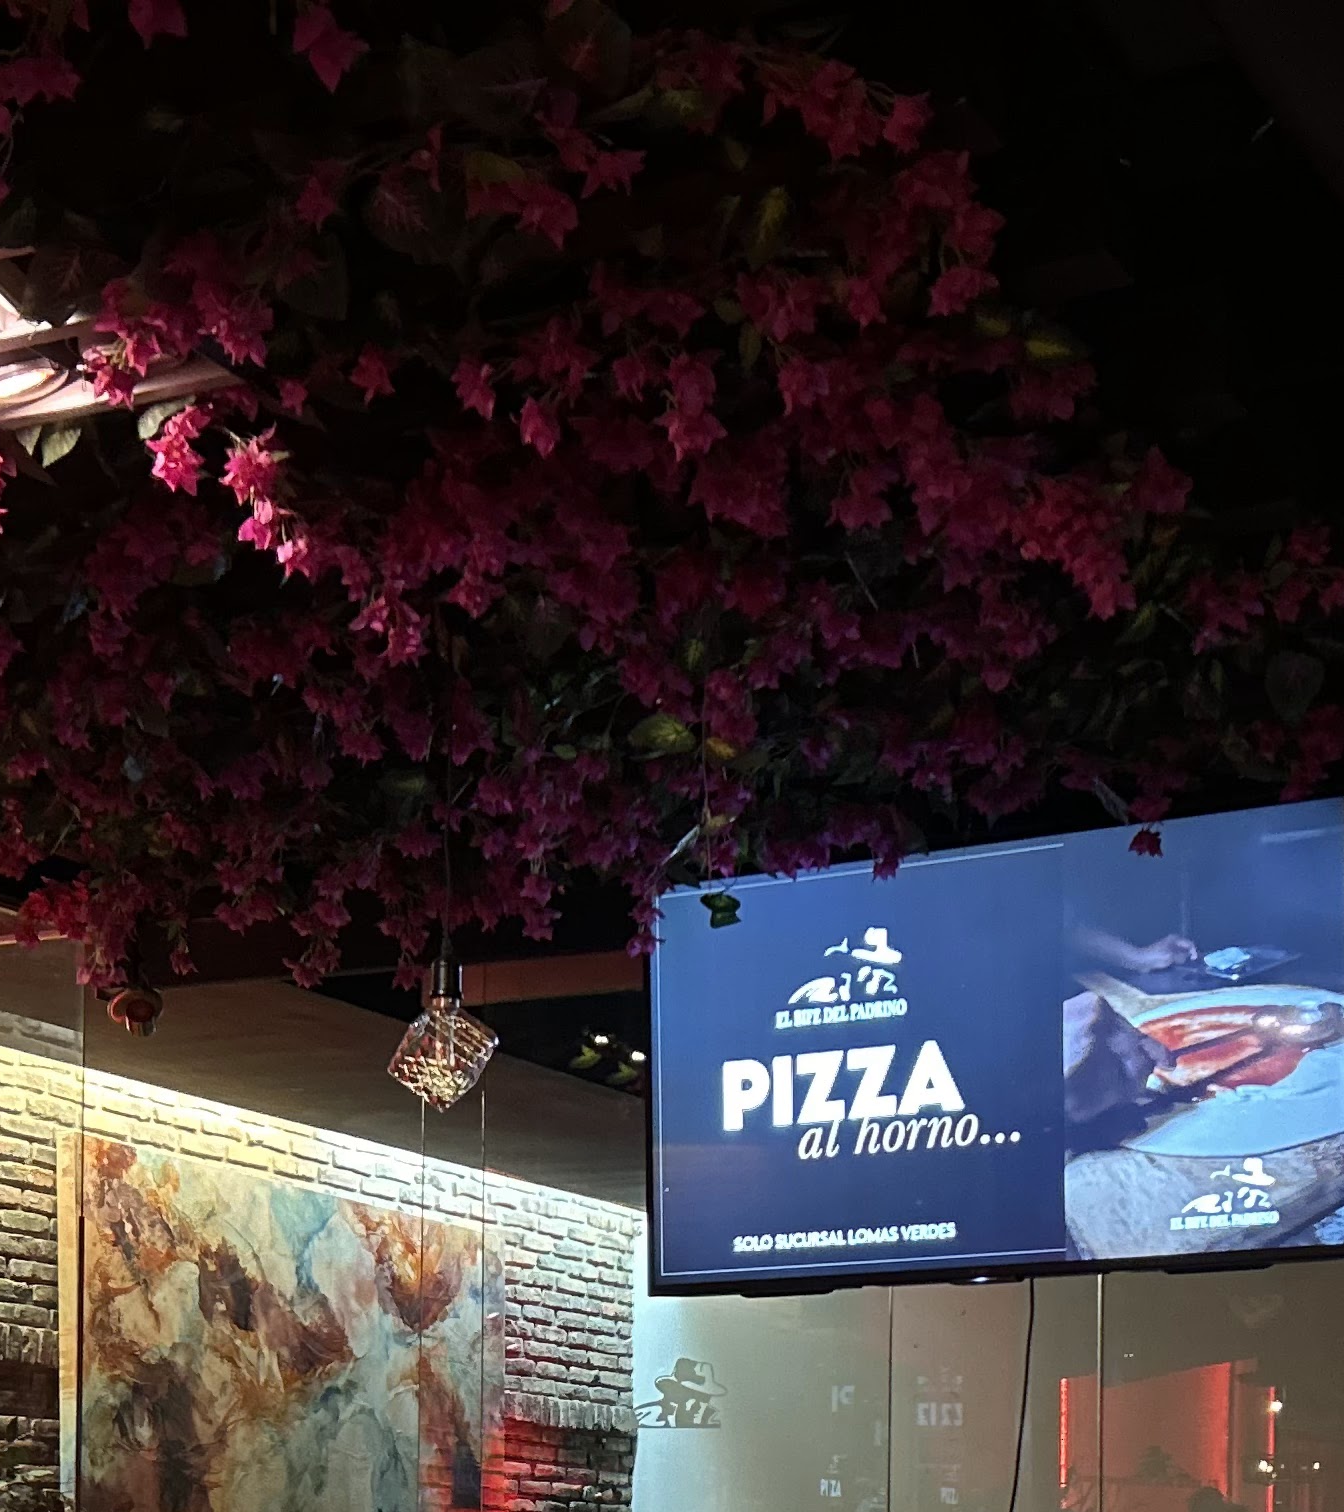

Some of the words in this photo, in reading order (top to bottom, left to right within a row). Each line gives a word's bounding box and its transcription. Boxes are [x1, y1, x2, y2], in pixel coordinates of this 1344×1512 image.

[775, 1010, 793, 1029] EL
[823, 1004, 848, 1024] DEL
[849, 997, 908, 1021] PADRINO
[722, 1039, 966, 1131] PIZZA
[798, 1118, 841, 1159] al
[854, 1113, 1022, 1155] horno...
[733, 1234, 773, 1252] SOLO
[774, 1229, 846, 1250] SUCURSAL
[847, 1225, 899, 1246] LOMAS
[900, 1221, 956, 1242] VERDES
